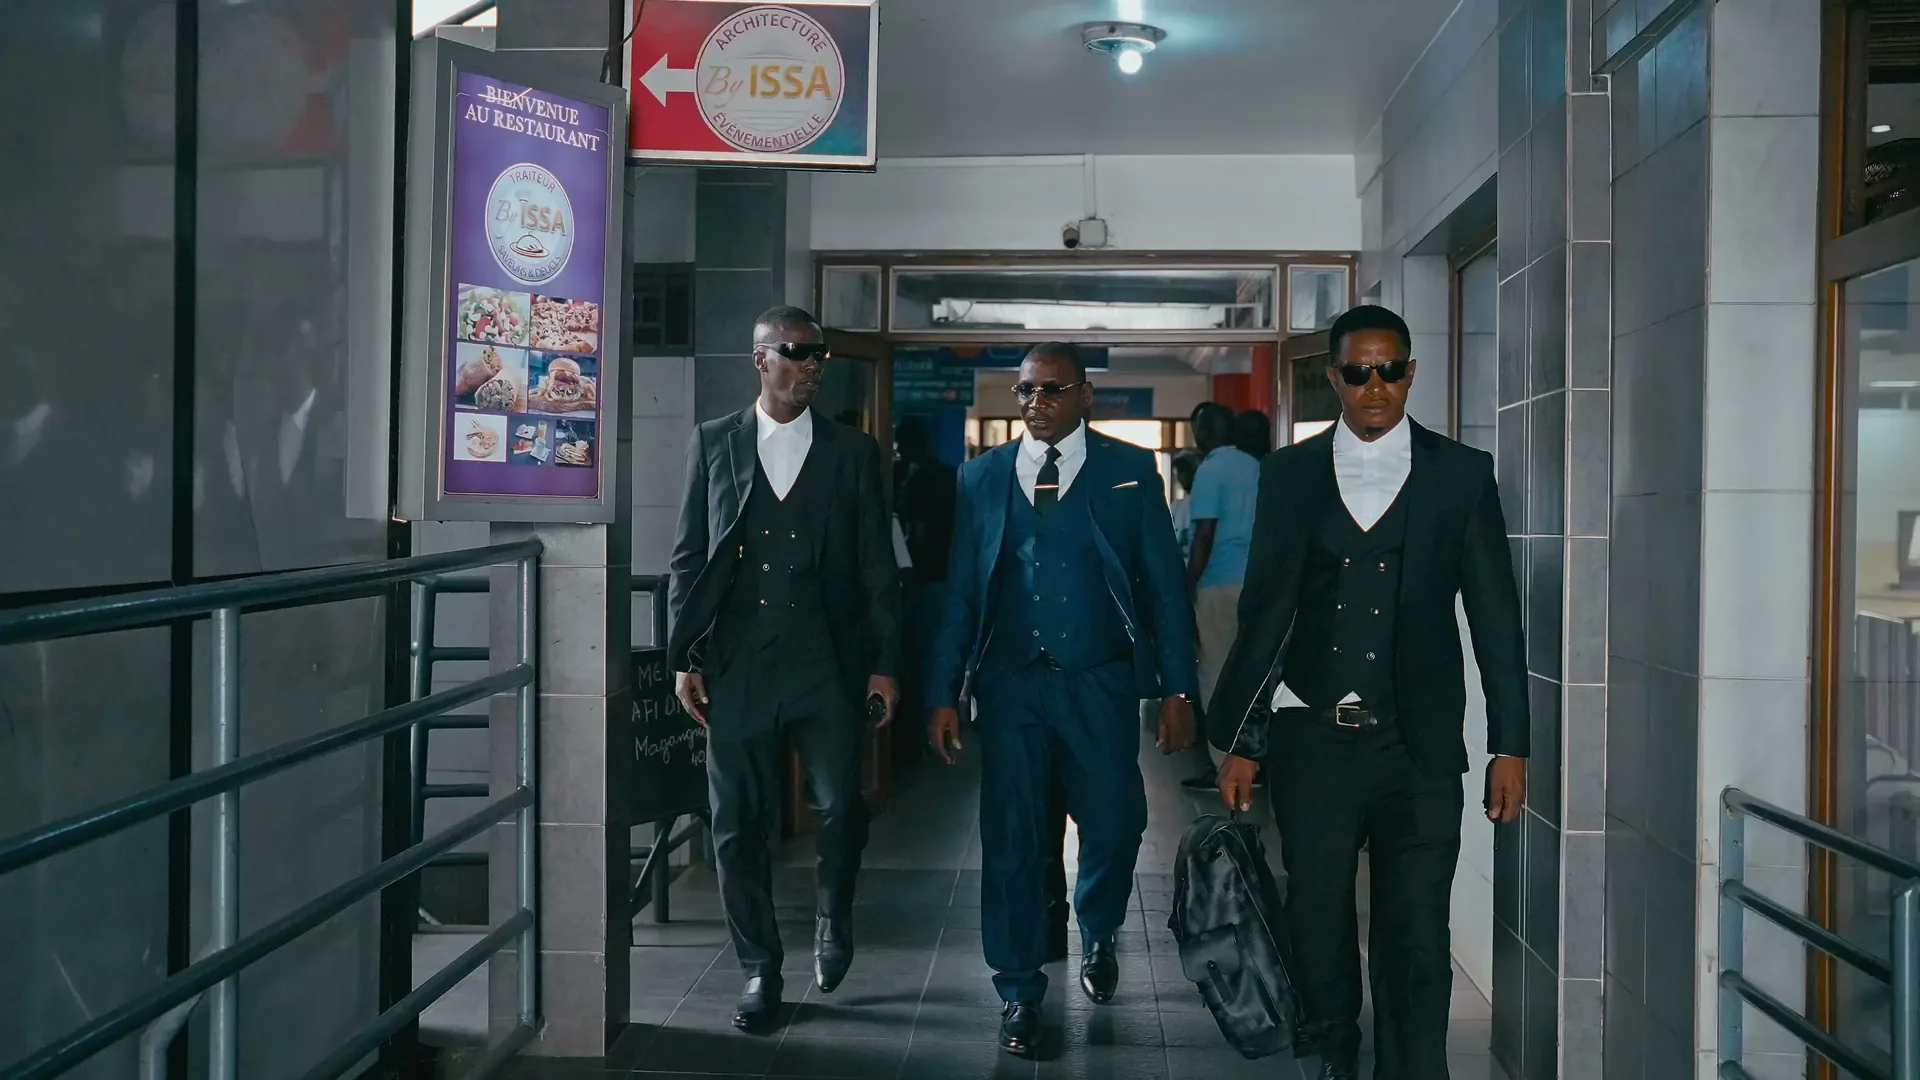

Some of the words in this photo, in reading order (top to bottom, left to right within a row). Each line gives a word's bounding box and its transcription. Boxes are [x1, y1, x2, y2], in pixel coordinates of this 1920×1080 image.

[715, 13, 827, 53] ARCHITECTURE
[486, 85, 580, 126] BIENVENUE
[703, 65, 744, 109] By
[749, 64, 832, 100] ISSA
[464, 103, 490, 124] AU
[493, 110, 600, 152] RESTAURANT
[509, 170, 556, 193] TRAITEUR
[520, 203, 567, 236] ISSA
[638, 661, 676, 691] MEN
